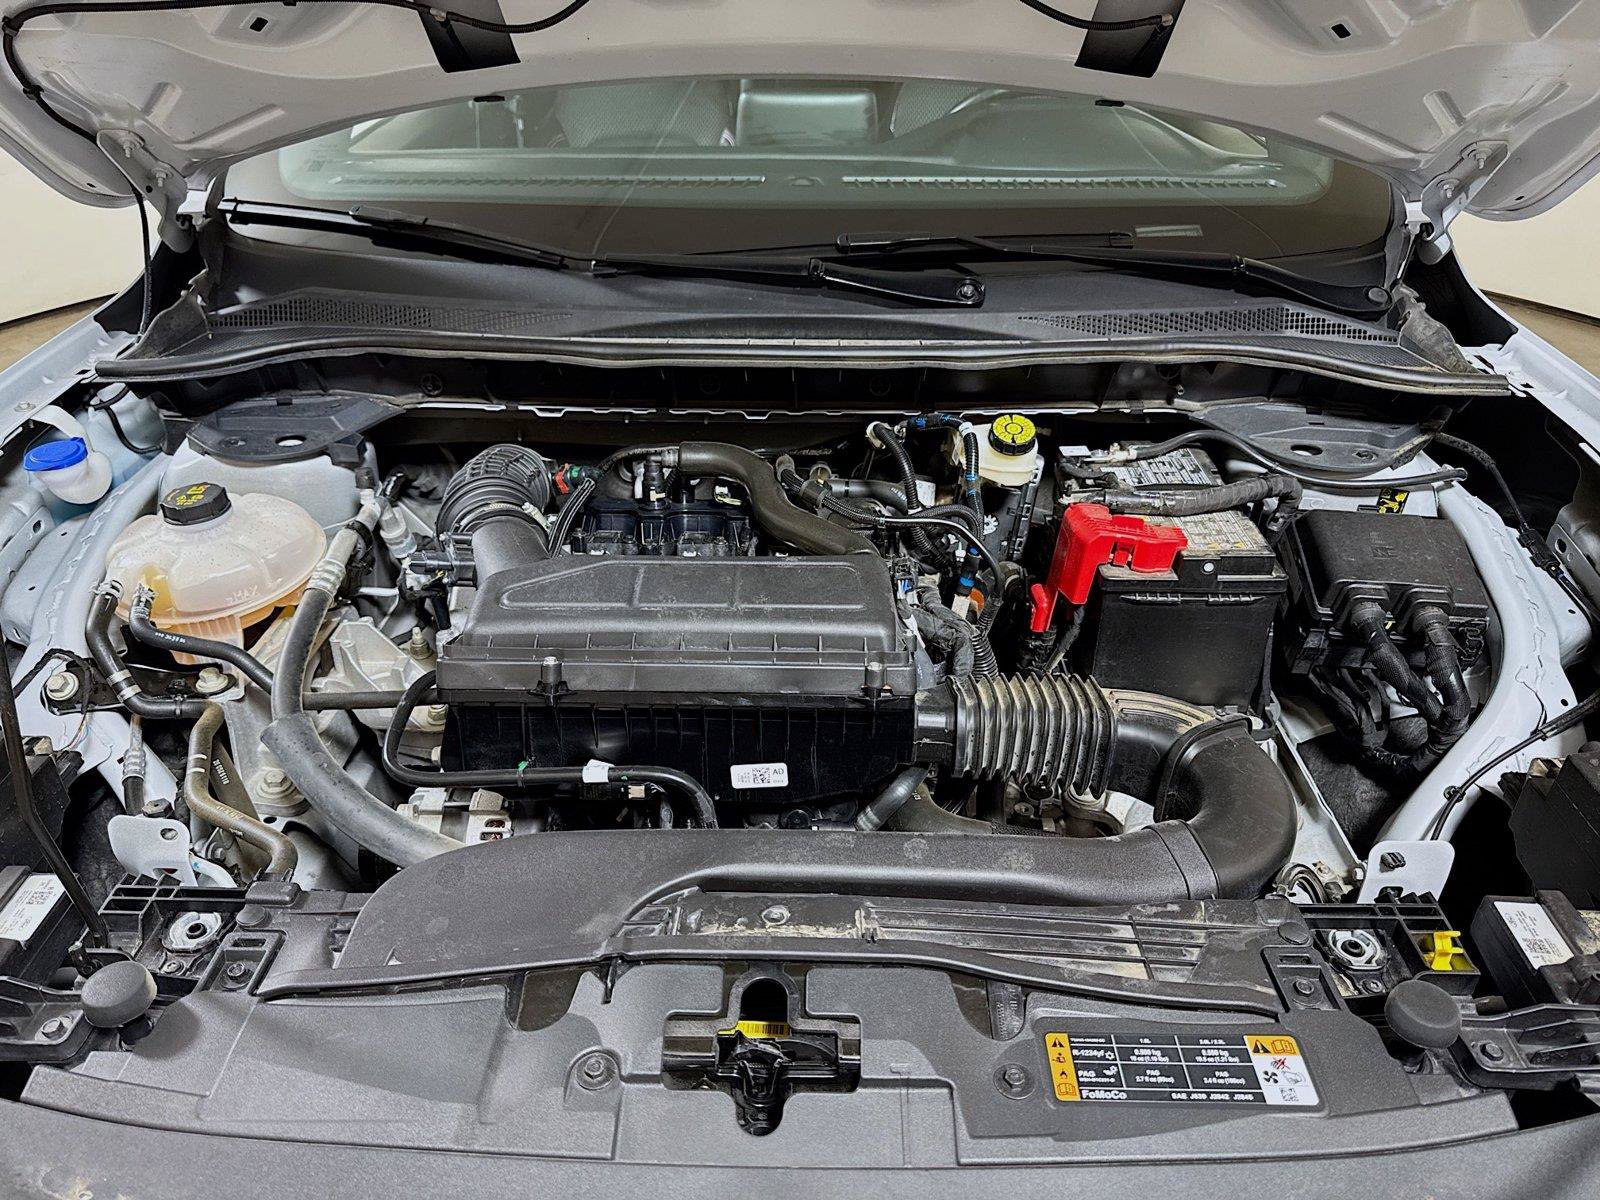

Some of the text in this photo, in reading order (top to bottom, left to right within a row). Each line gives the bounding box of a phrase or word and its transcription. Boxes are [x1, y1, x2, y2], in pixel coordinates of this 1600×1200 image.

[1072, 1049, 1105, 1057] R-1234yf
[1152, 1049, 1161, 1058] kg
[1219, 1049, 1229, 1058] kg
[1082, 1090, 1127, 1099] FoMoCo
